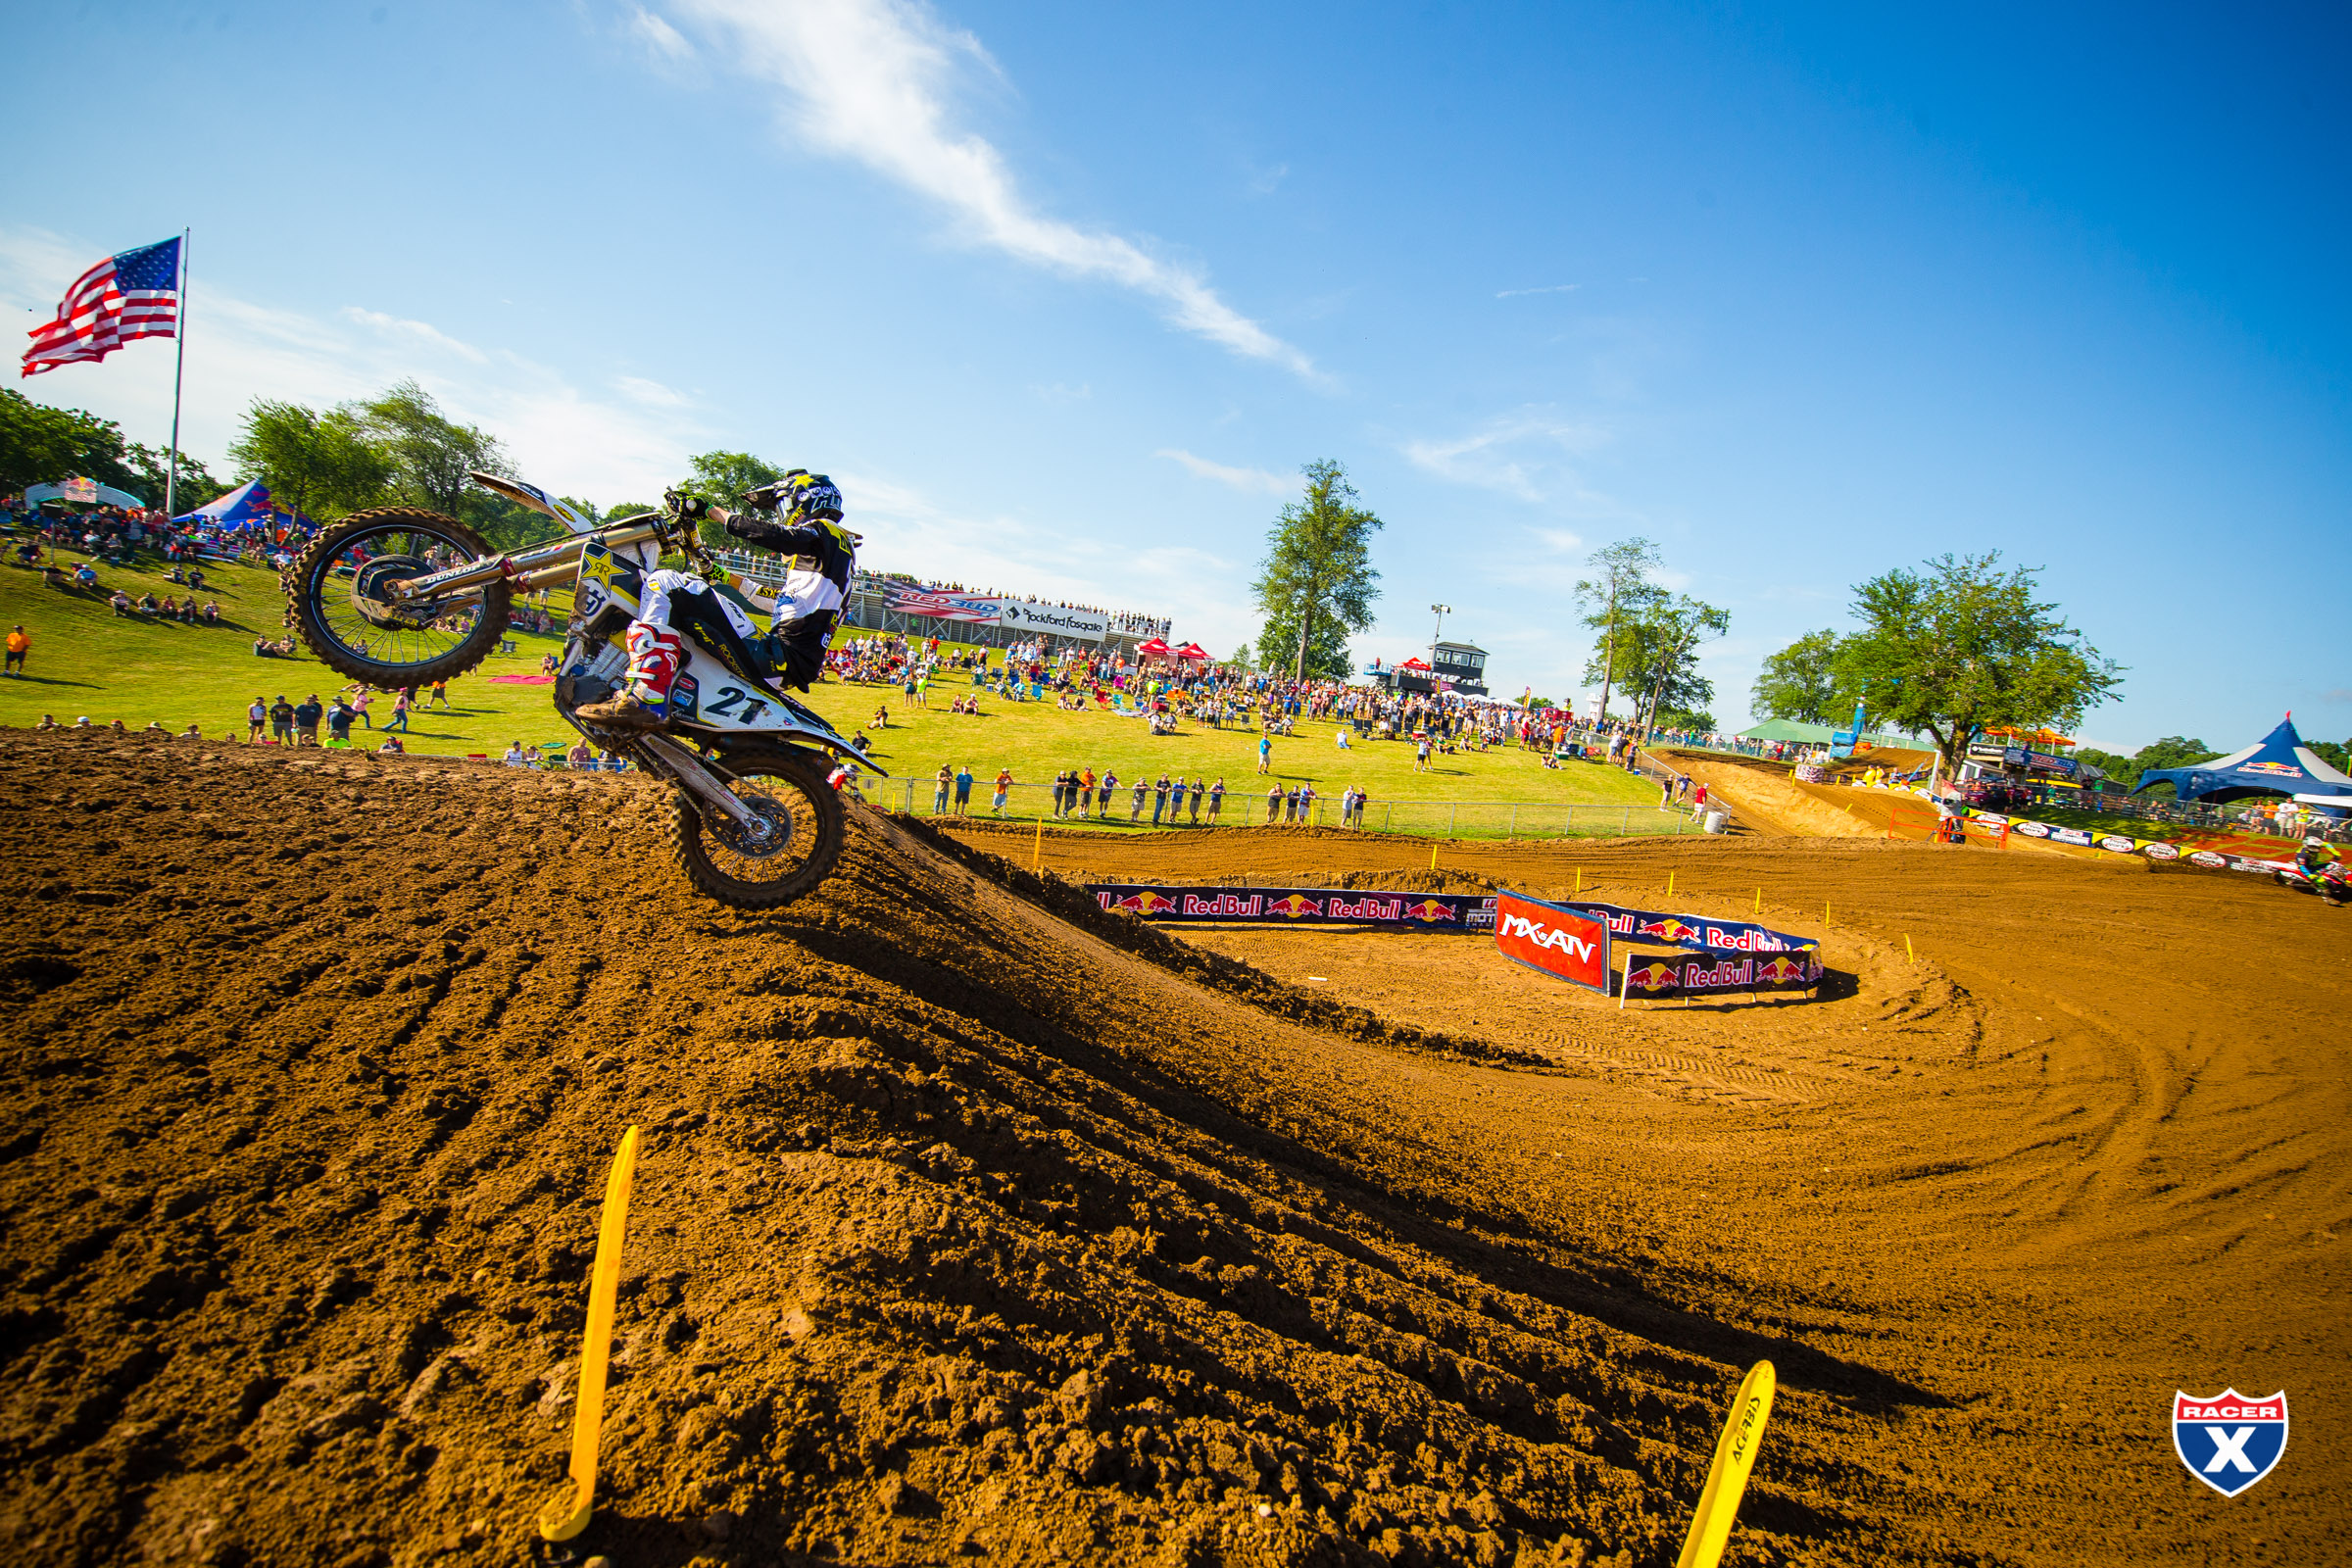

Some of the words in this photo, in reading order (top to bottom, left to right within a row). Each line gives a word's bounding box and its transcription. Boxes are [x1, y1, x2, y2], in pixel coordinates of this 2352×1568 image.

[425, 565, 481, 584] DUNLOP
[1023, 608, 1065, 626] Rockford
[1066, 616, 1102, 632] Fosgate
[705, 687, 768, 725] 21
[1183, 895, 1224, 914] Red
[1224, 895, 1262, 915] Bull
[1329, 898, 1366, 918] Red
[1365, 899, 1400, 919] Bull
[1706, 926, 1752, 951] Red
[1685, 961, 1723, 988] Red
[1722, 959, 1752, 986] Bull
[1733, 1396, 1761, 1465] ACERBIS
